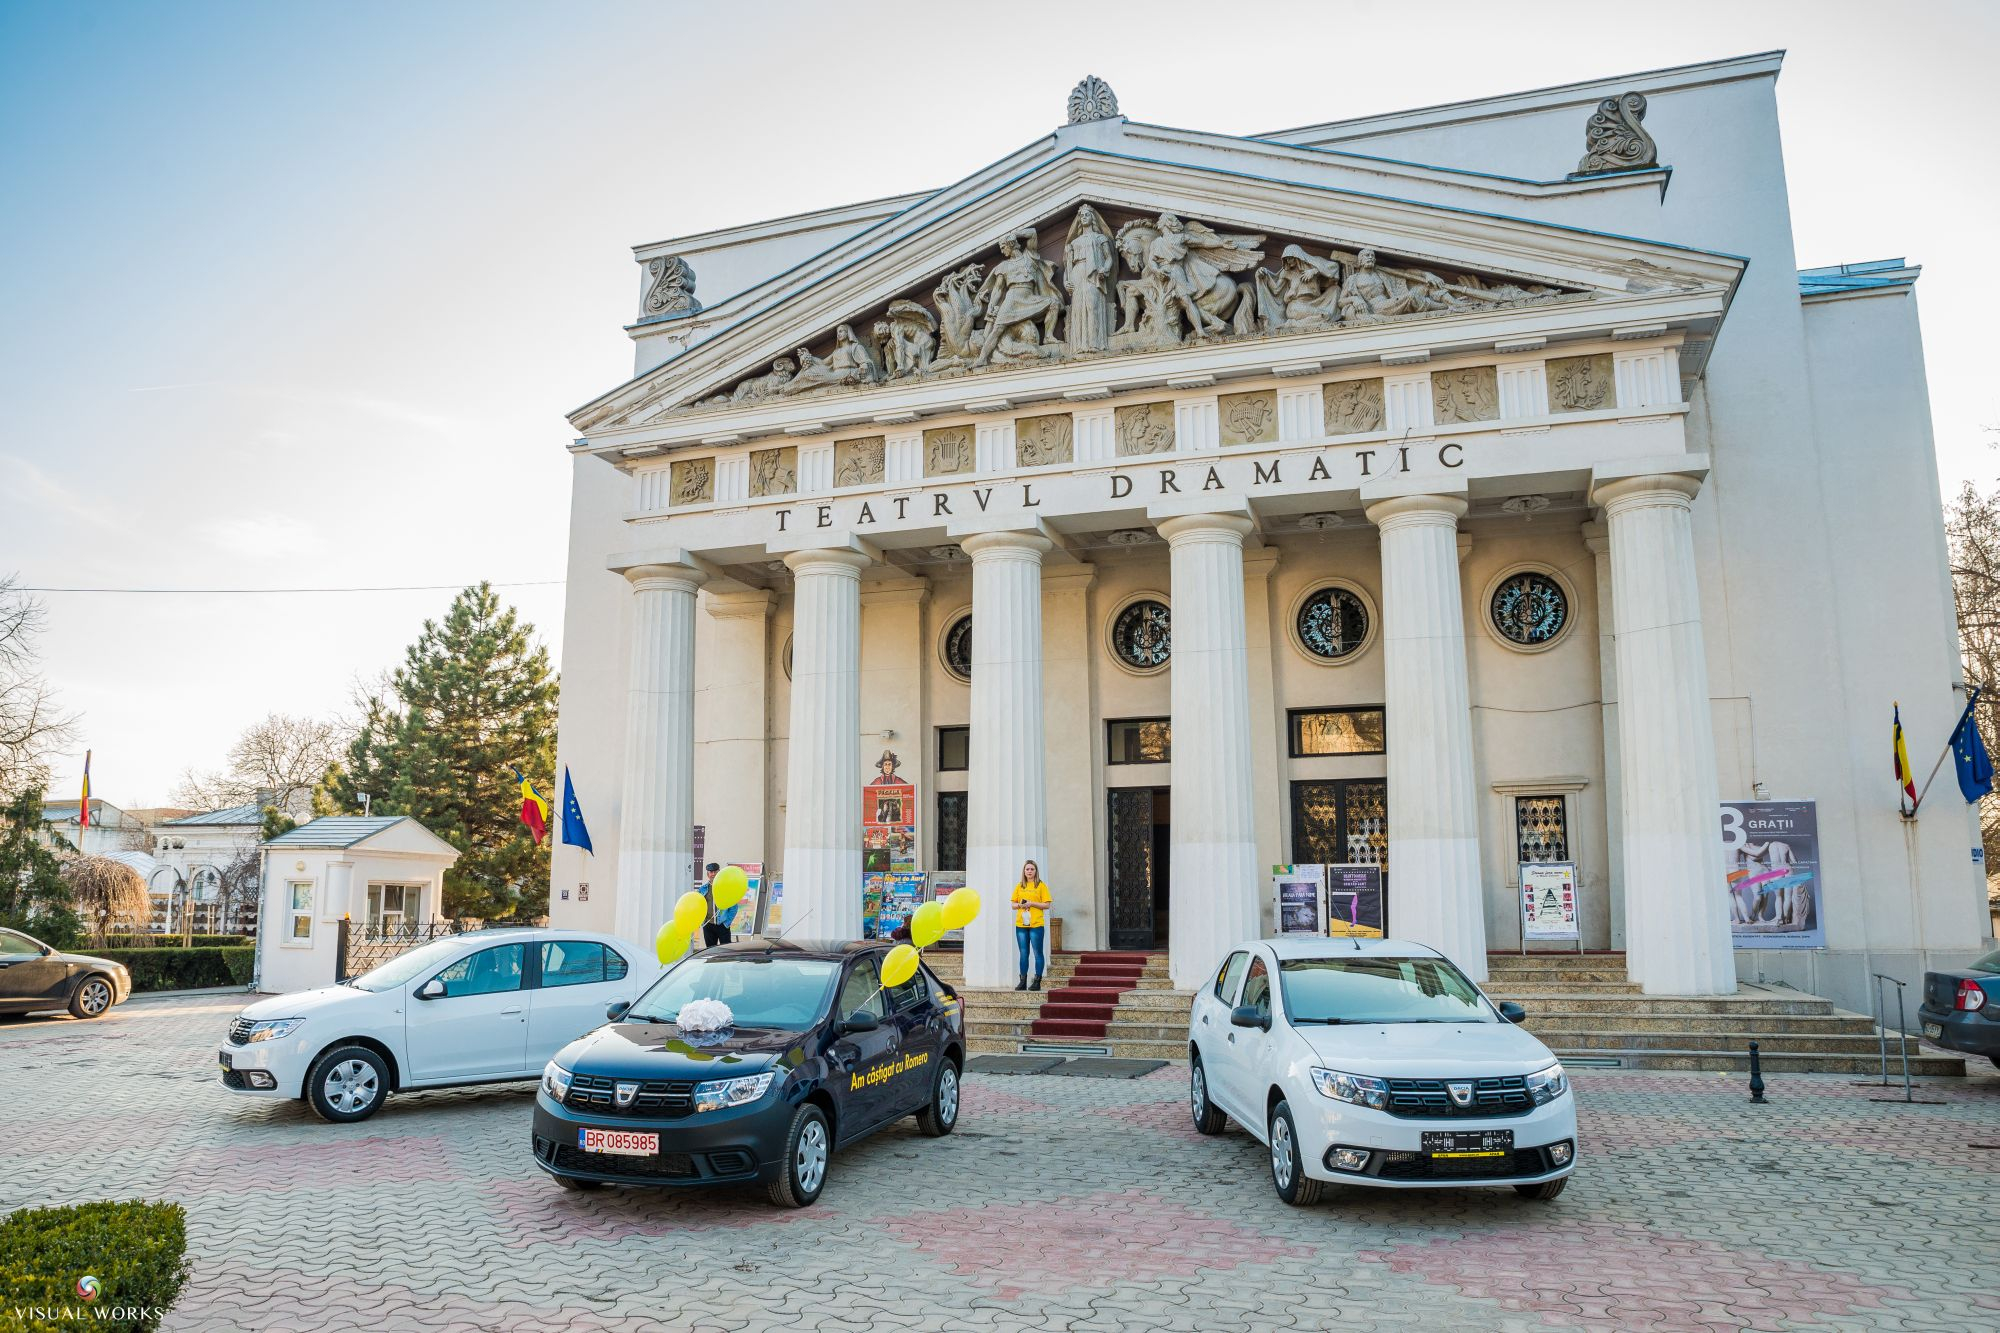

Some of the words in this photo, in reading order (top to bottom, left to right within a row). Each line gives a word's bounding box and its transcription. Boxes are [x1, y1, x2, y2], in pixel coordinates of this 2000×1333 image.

[776, 484, 1041, 532] TEATRVL
[1110, 443, 1464, 499] DRAMATIC
[1720, 807, 1747, 850] 3
[850, 1072, 865, 1092] Am
[866, 1061, 894, 1086] câștigat
[896, 1060, 903, 1074] cu
[905, 1052, 928, 1070] Romero
[587, 1132, 605, 1147] BR
[607, 1134, 656, 1150] 085985
